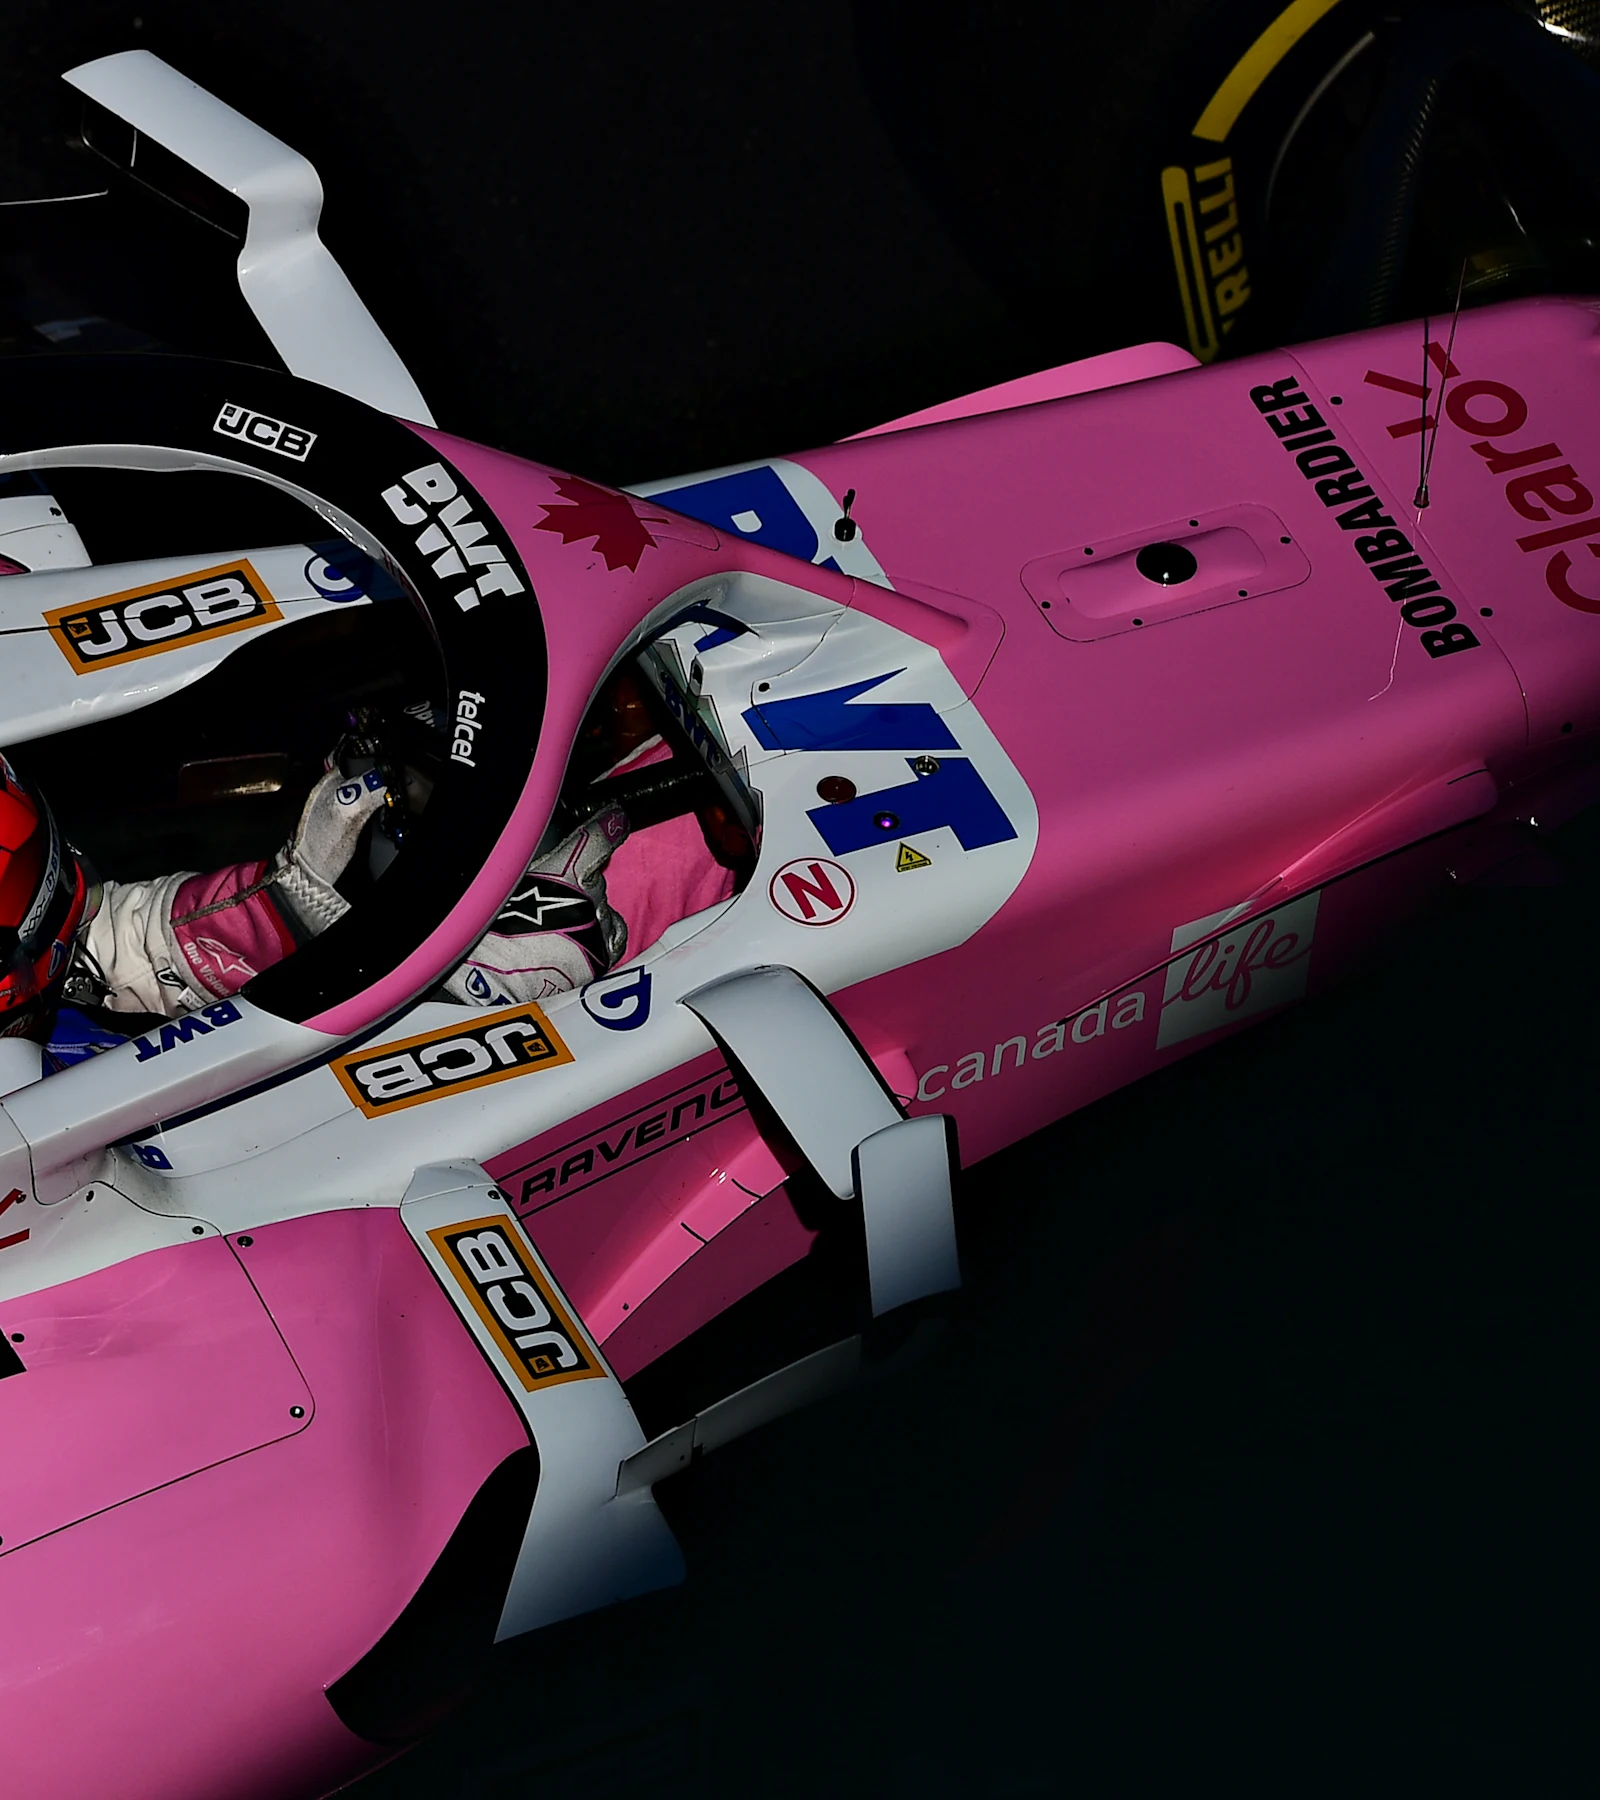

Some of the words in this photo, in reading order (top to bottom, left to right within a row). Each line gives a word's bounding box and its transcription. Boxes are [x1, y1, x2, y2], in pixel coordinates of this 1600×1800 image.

[219, 405, 312, 457] JCB
[380, 461, 527, 613] BWT
[1250, 376, 1481, 659] BOMBARDIER
[78, 577, 258, 656] JCB
[450, 690, 486, 768] telcel
[781, 862, 843, 920] N
[132, 1000, 243, 1063] BWT
[916, 991, 1146, 1102] canada
[1160, 919, 1314, 1011] life
[355, 1013, 538, 1099] JCB
[456, 1231, 580, 1370] JCB
